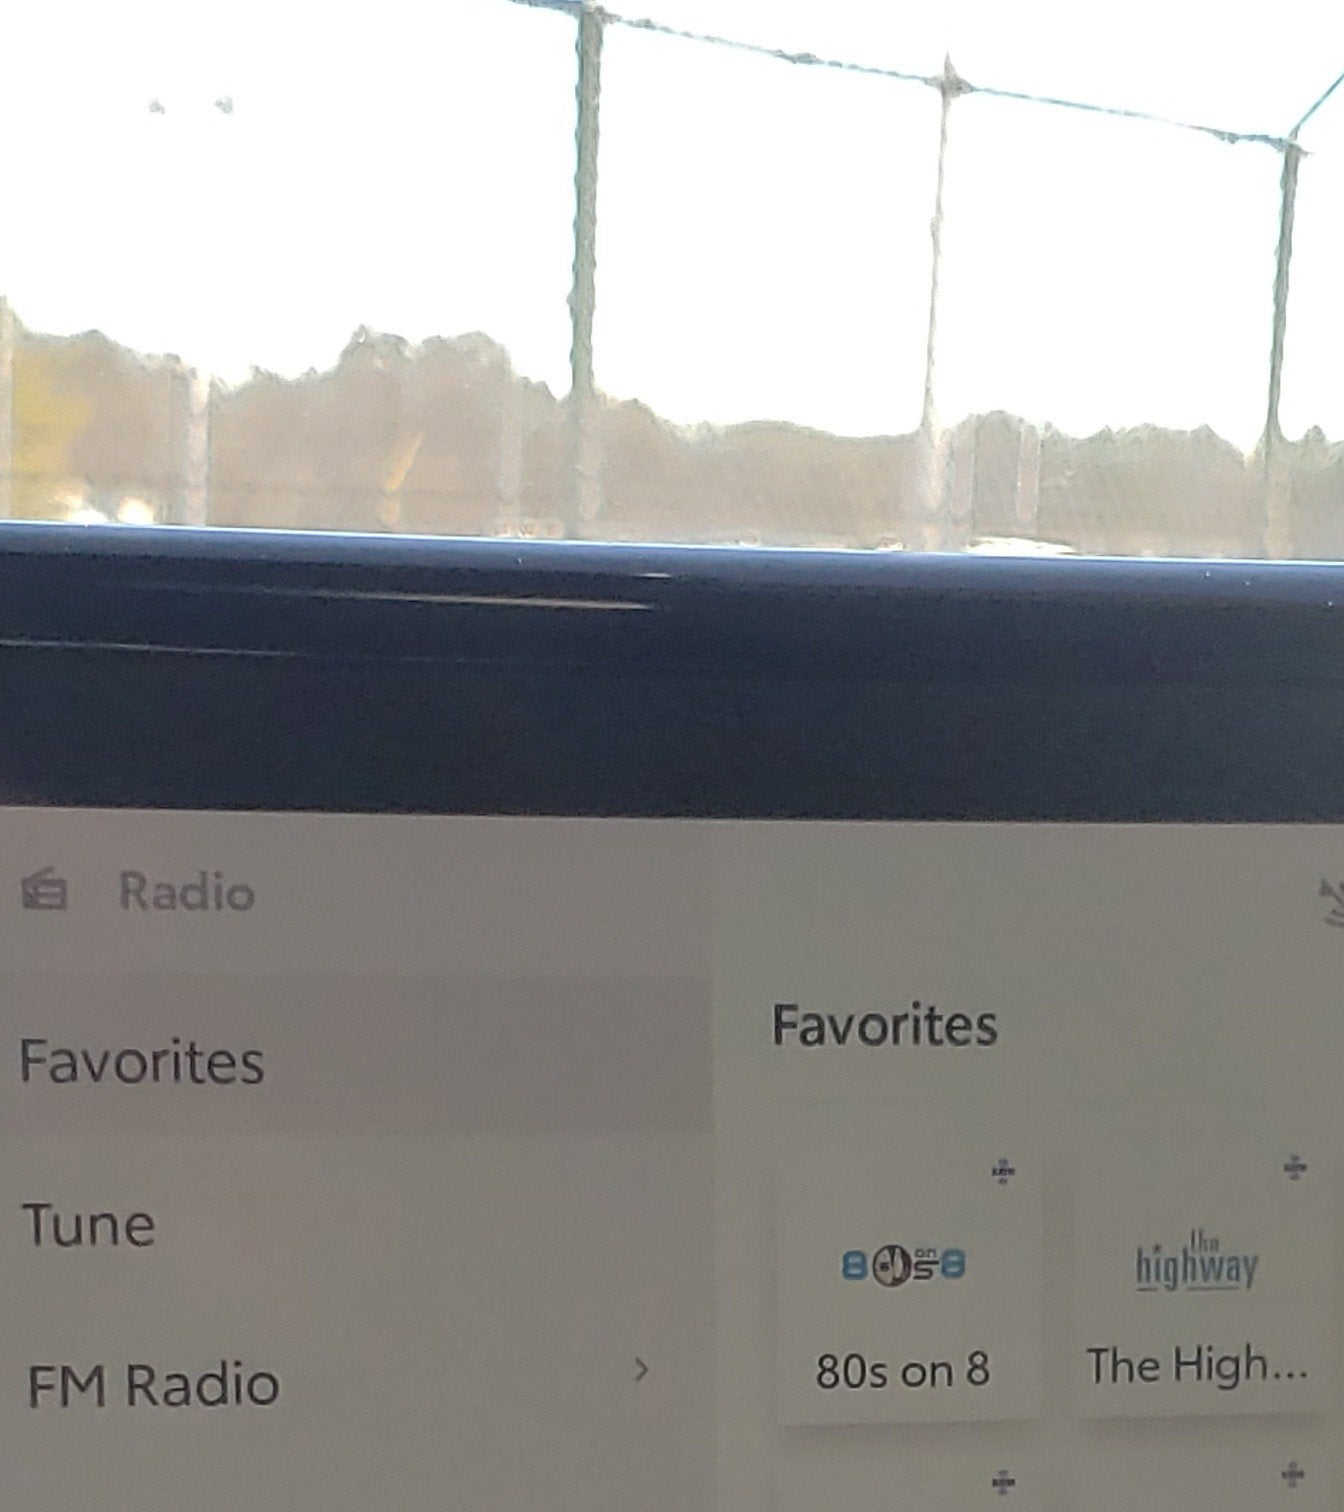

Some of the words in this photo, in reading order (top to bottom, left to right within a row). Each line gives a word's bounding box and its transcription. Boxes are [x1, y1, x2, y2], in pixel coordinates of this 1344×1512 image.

[119, 870, 256, 912] Radio
[773, 1001, 999, 1048] Favorites
[19, 1037, 266, 1085] Favorites
[22, 1201, 156, 1249] Tune
[1136, 1243, 1258, 1291] highway
[27, 1364, 106, 1409] FM
[126, 1360, 280, 1408] Radio
[816, 1352, 888, 1389] 80s
[901, 1361, 953, 1388] on
[967, 1350, 990, 1386] 8
[1086, 1346, 1160, 1384] The
